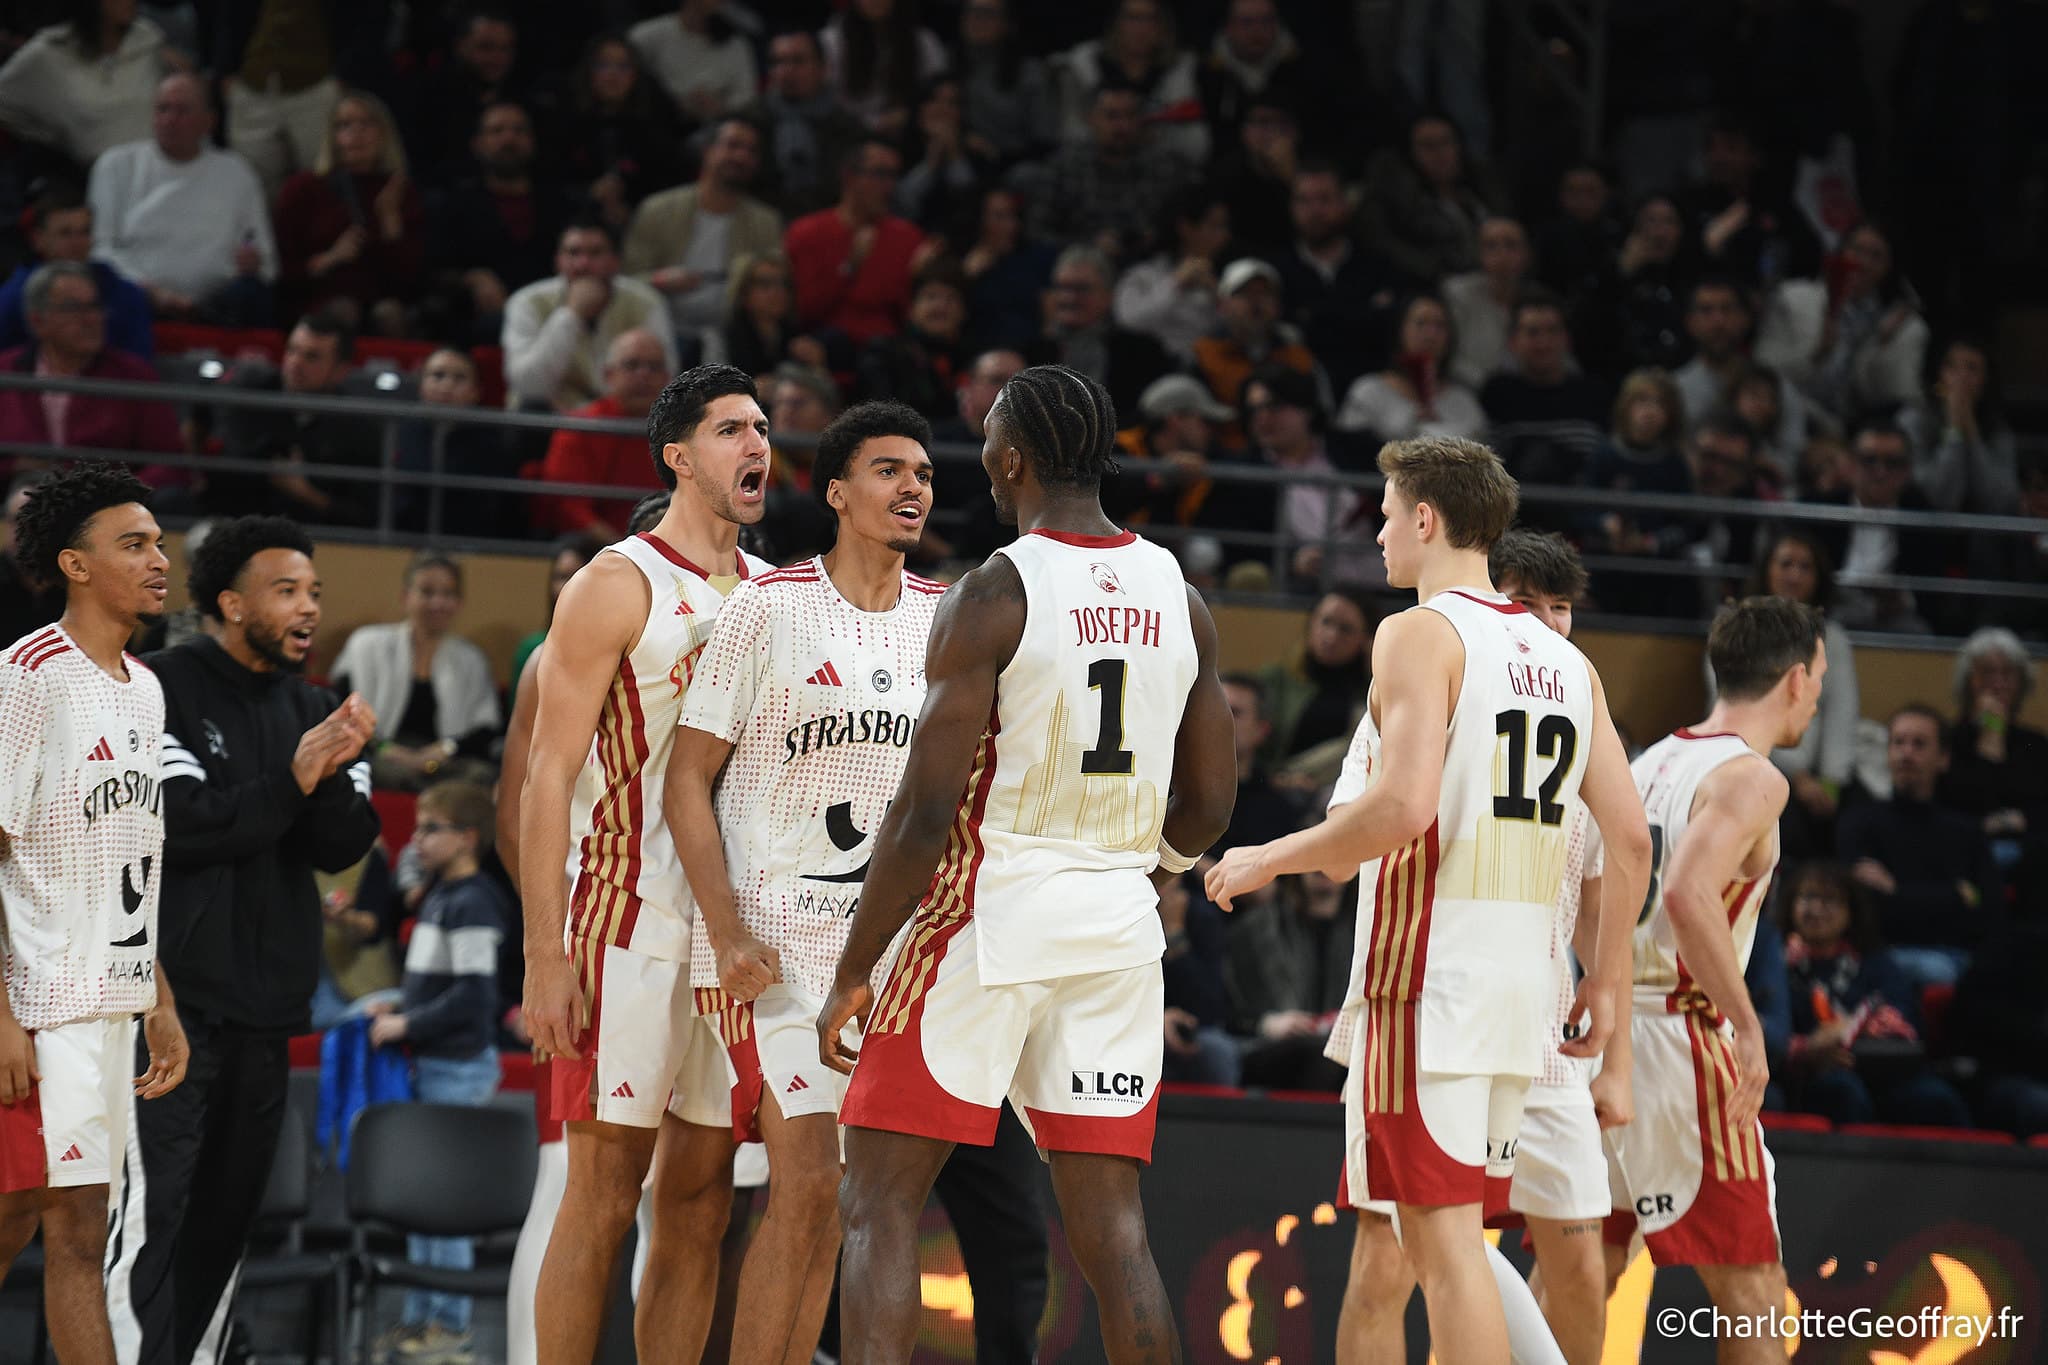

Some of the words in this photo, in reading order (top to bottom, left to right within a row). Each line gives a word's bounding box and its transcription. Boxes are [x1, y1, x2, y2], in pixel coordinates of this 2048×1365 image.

[1069, 606, 1161, 648] JOSEPH
[1507, 662, 1565, 704] GREGG
[1080, 658, 1136, 777] 1
[1493, 709, 1578, 828] 12
[1096, 1071, 1144, 1098] LCR
